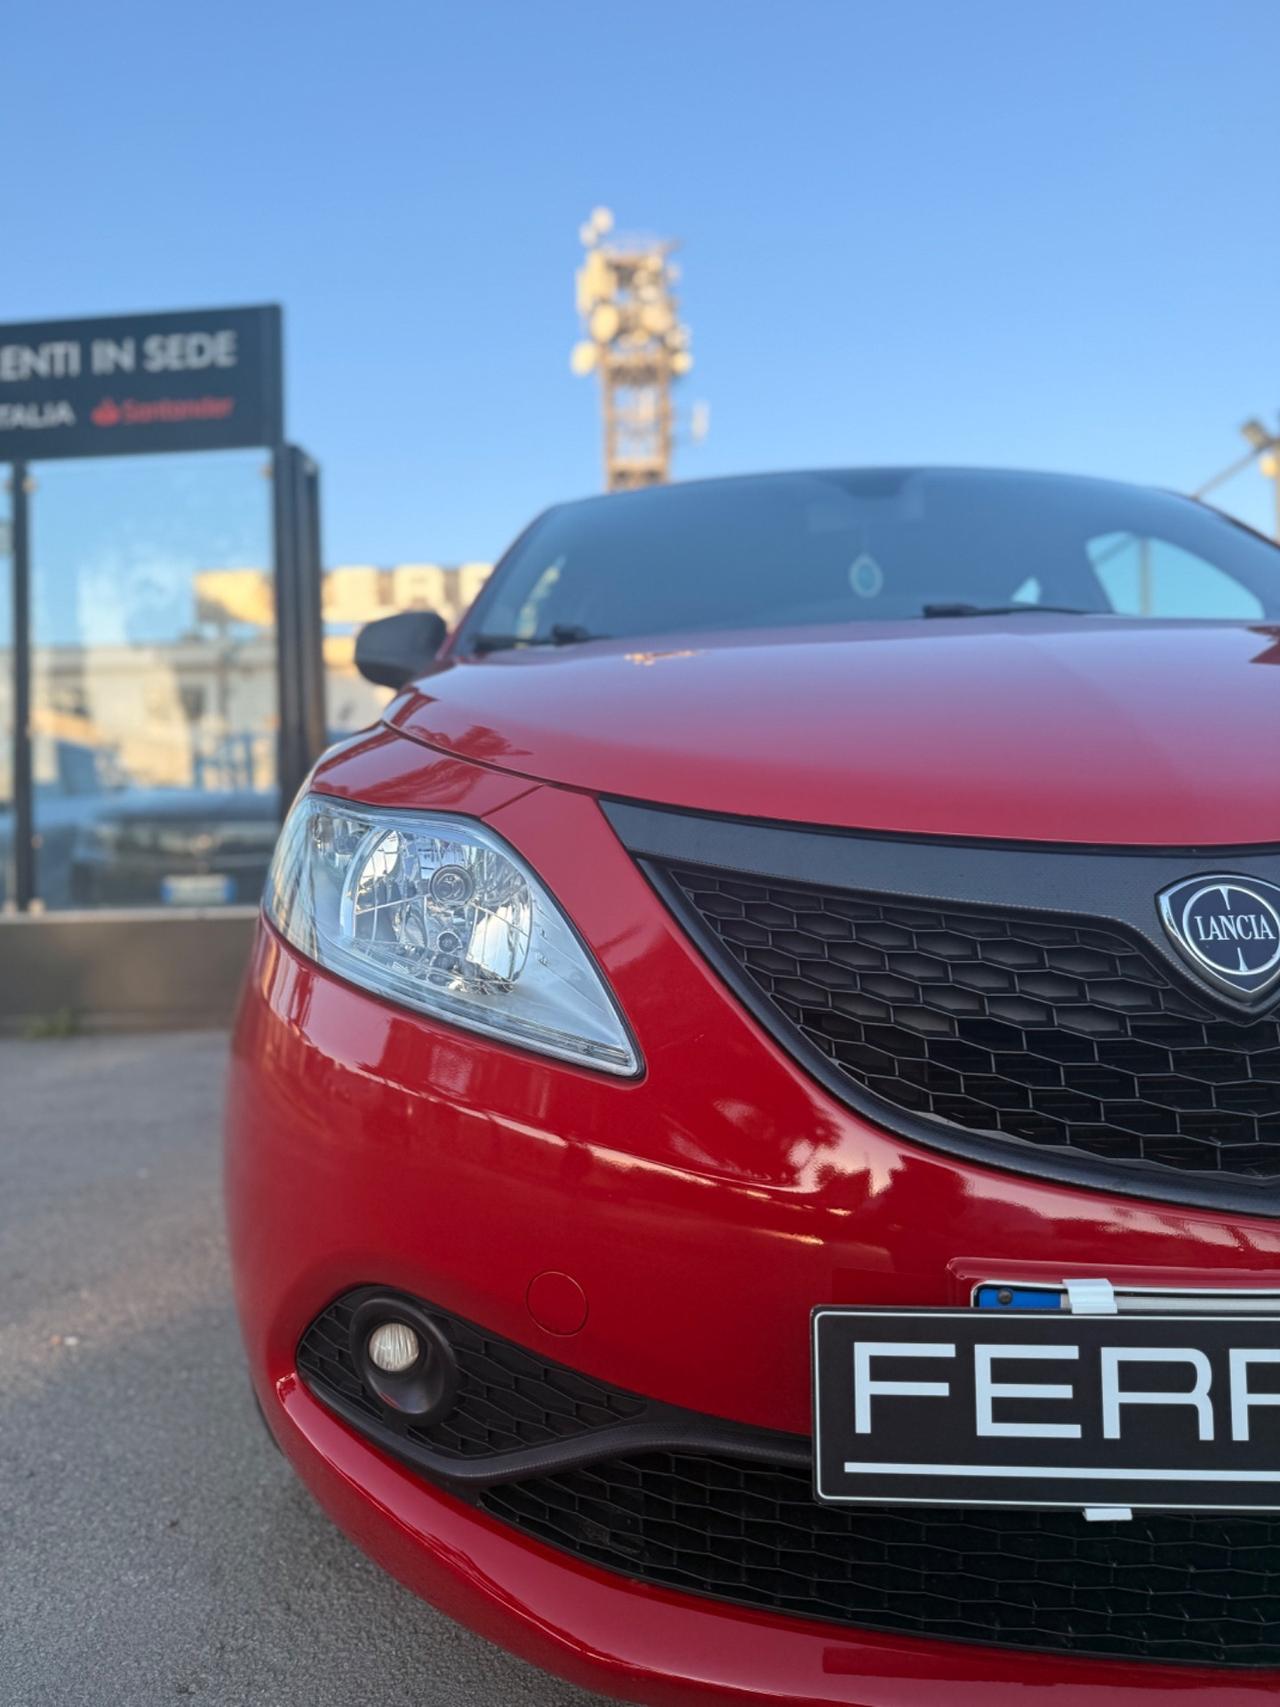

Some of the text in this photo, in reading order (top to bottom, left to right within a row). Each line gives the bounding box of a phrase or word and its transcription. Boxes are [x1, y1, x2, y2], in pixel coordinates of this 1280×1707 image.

[91, 337, 135, 374] IN
[143, 330, 237, 373] SEDE
[123, 398, 233, 422] Santander
[1194, 914, 1277, 941] LANCIA
